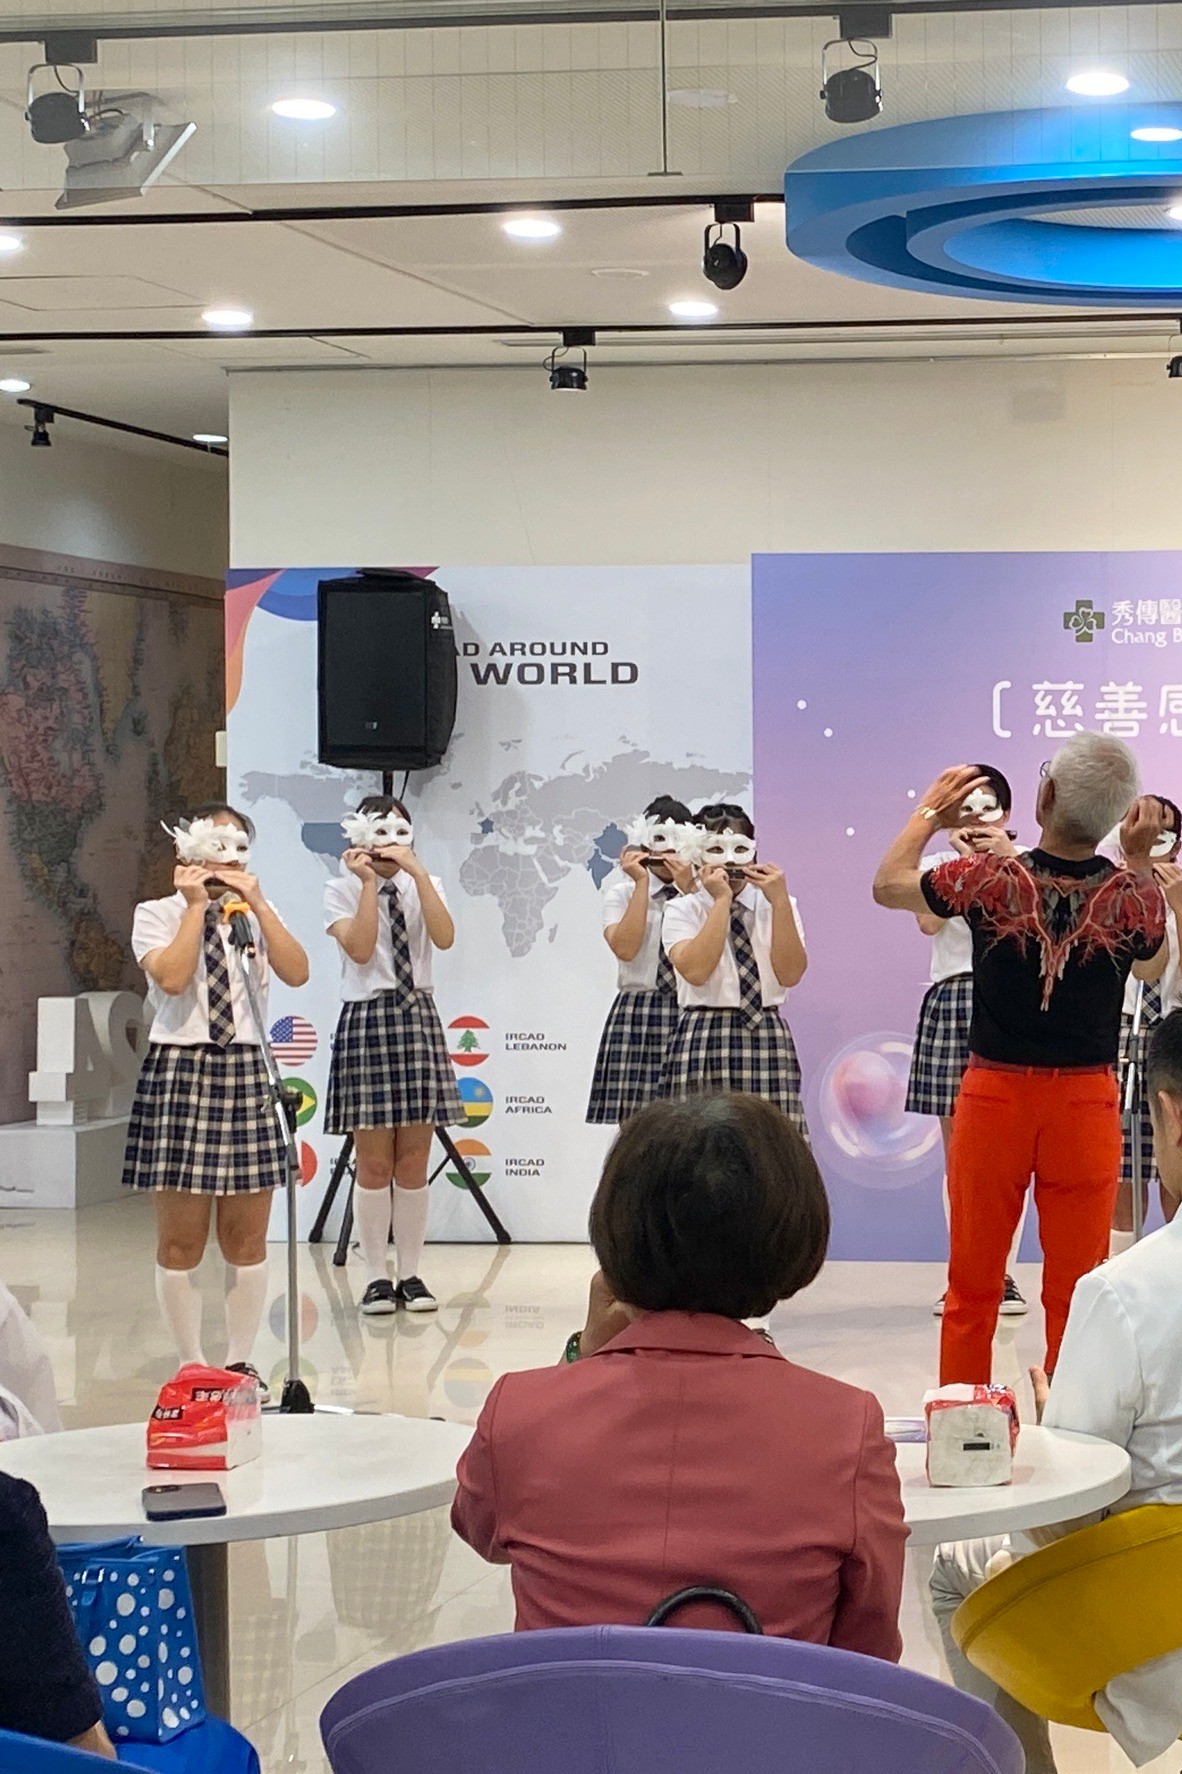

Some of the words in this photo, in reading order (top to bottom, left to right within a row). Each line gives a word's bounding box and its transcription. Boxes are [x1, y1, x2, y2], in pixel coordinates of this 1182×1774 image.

[1110, 626, 1168, 648] Chang
[488, 641, 610, 657] AROUND
[470, 662, 640, 685] WORLD
[504, 1033, 546, 1041] IRCAD
[504, 1042, 567, 1051] LEBANON
[504, 1096, 545, 1104] IRCAD
[504, 1105, 553, 1114] AFRICA
[504, 1158, 545, 1167] IRCAD
[504, 1168, 541, 1177] INDIA
